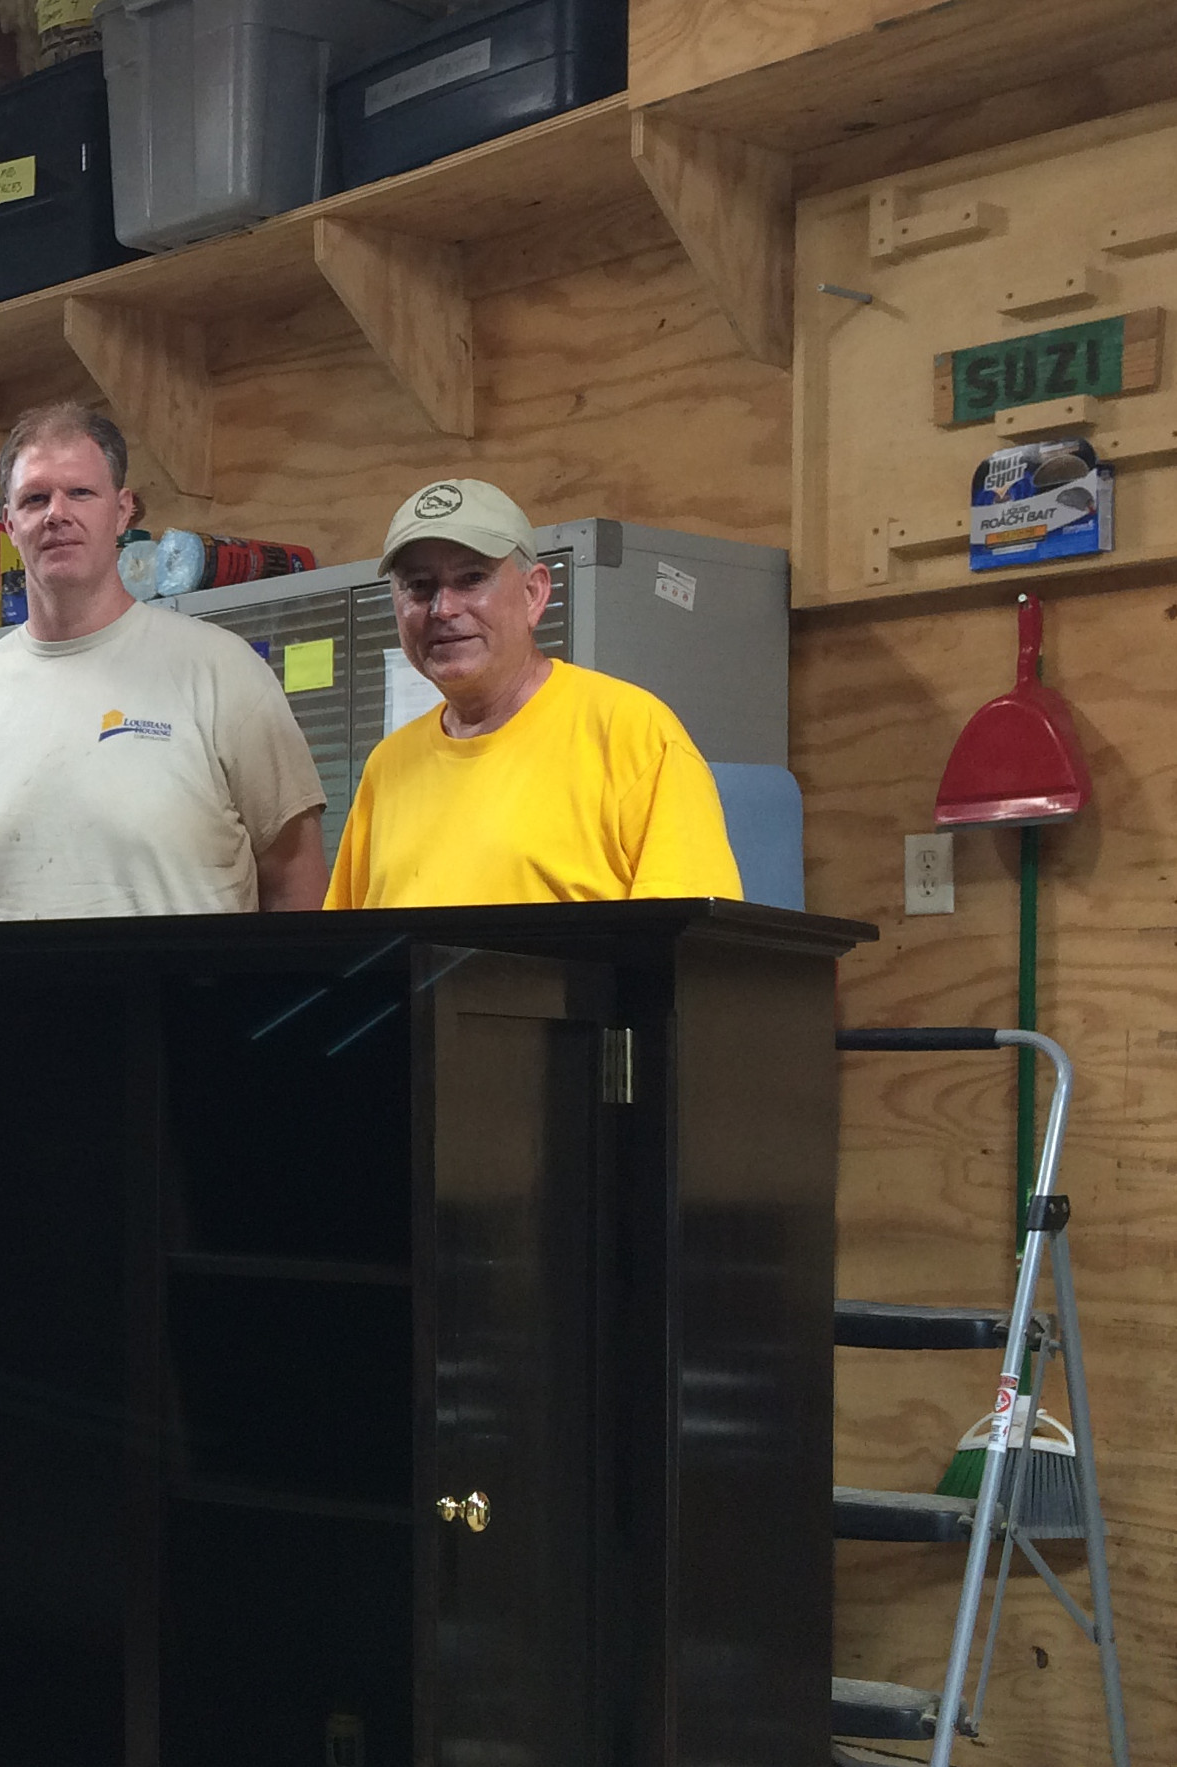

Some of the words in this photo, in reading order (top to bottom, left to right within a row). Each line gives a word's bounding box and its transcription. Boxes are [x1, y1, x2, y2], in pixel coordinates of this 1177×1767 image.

[967, 340, 1101, 409] SUZI
[991, 454, 1022, 475] HOT
[985, 465, 1026, 490] SHOT
[980, 512, 1025, 531] ROACH
[1026, 508, 1057, 522] BAIT
[1002, 505, 1031, 517] LIQUID
[123, 717, 172, 730] LOUISIANA
